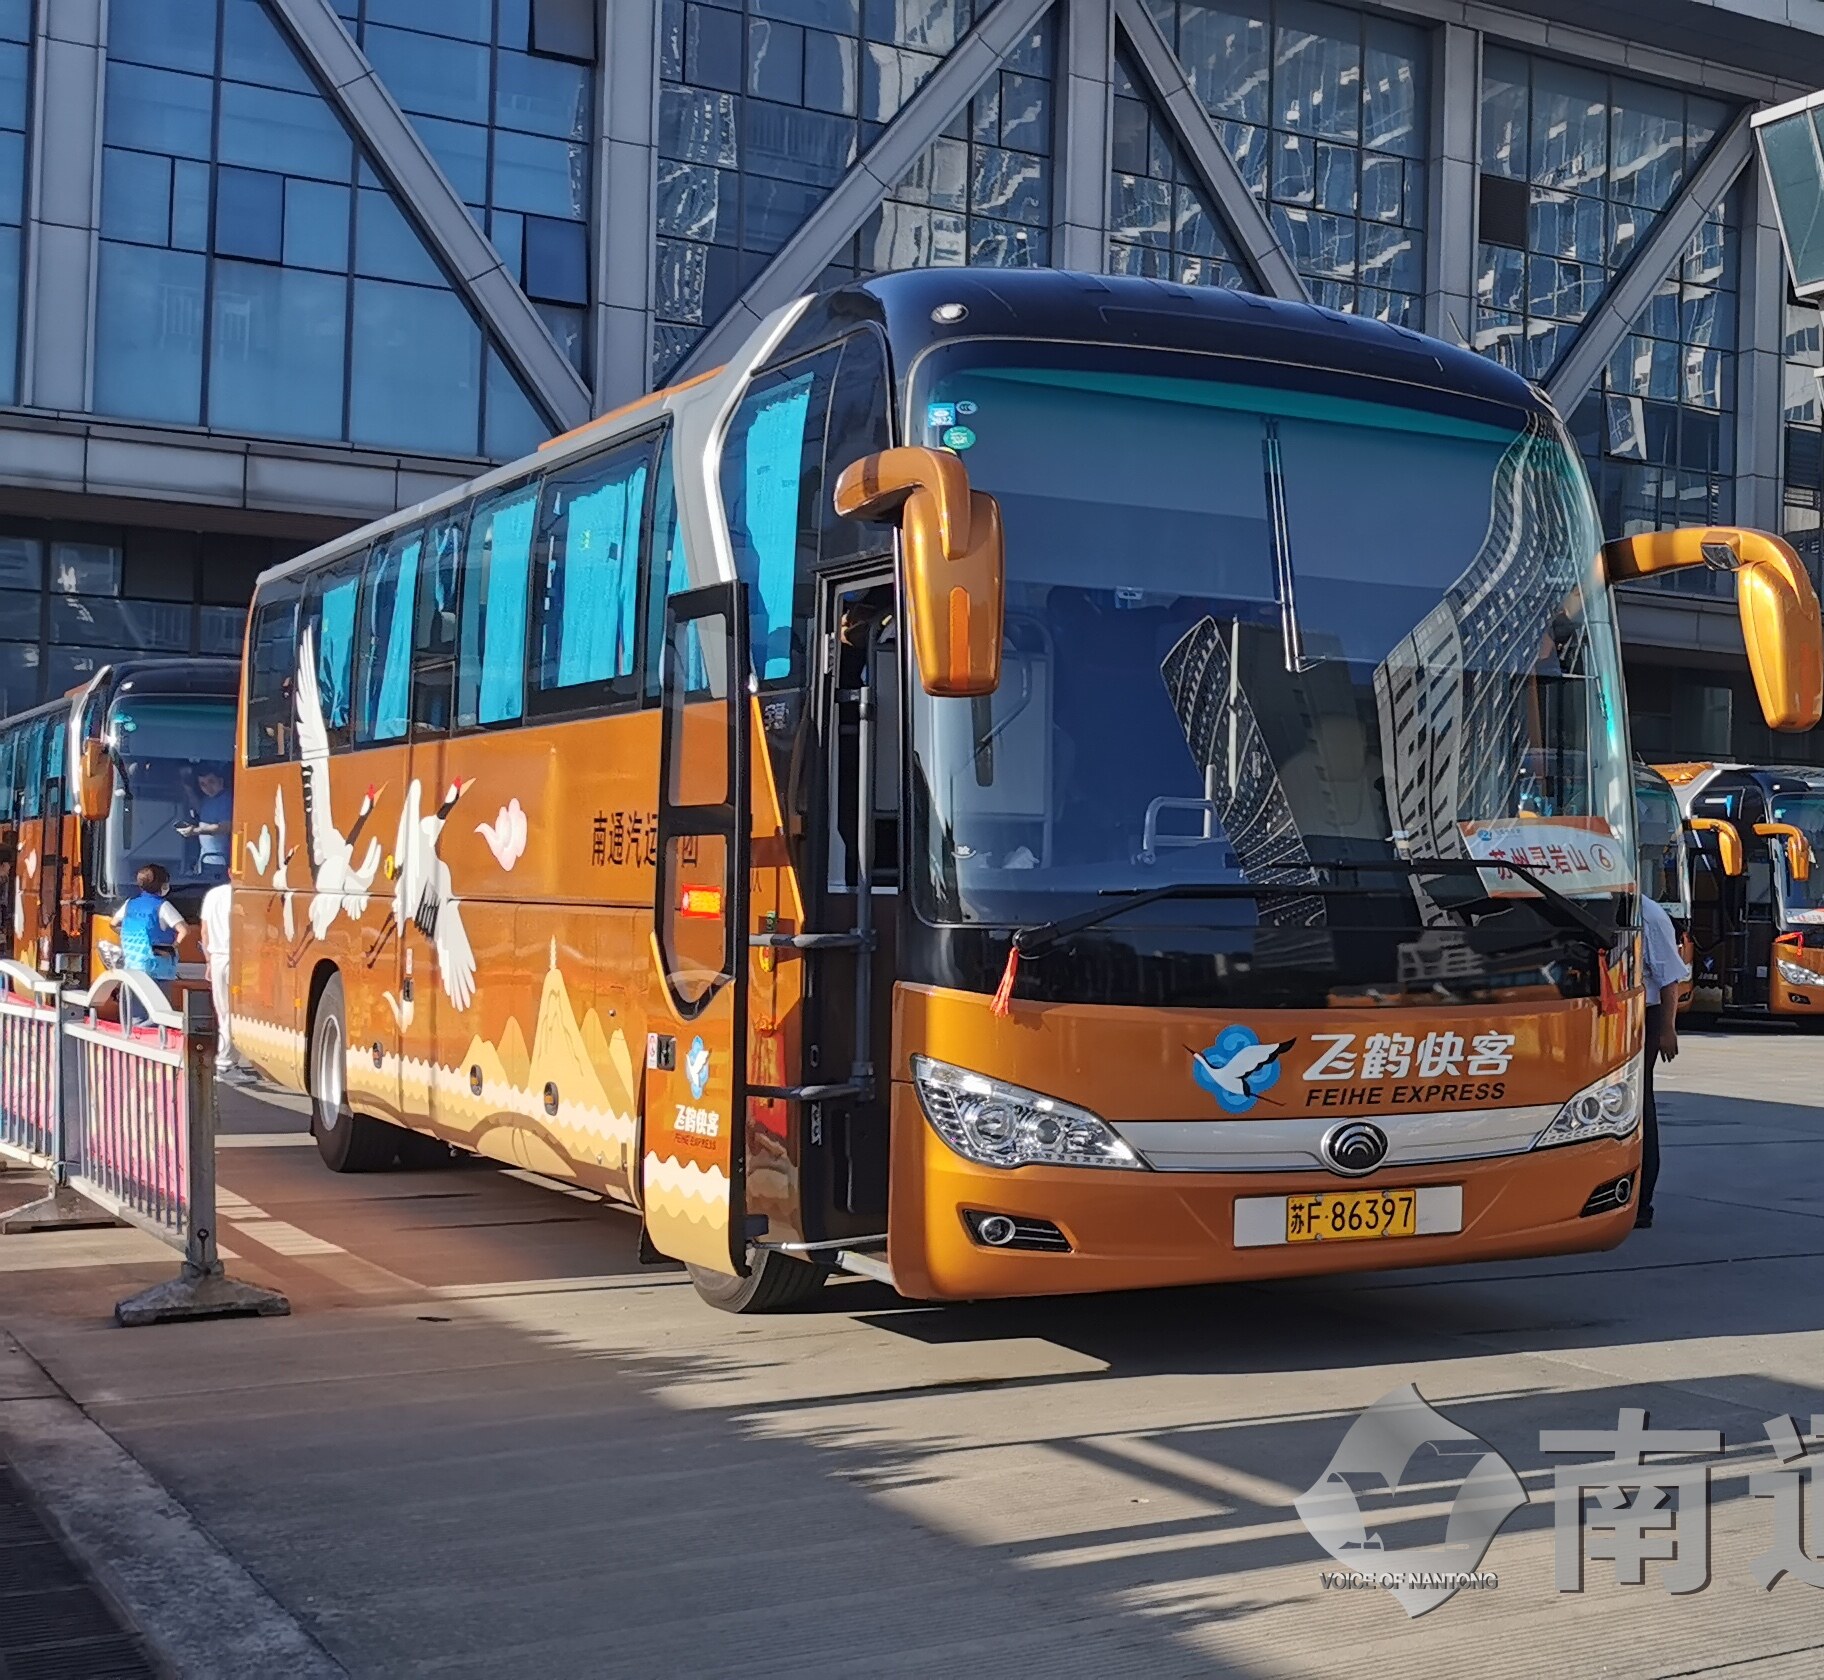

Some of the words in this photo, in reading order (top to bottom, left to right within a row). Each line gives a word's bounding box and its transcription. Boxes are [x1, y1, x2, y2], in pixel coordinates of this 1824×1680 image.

[1302, 1029, 1516, 1081] 飞鹤快客
[1305, 1087, 1384, 1107] FEIHE
[1391, 1083, 1506, 1104] EXPRESS
[674, 1104, 720, 1137] 飞鹤快客
